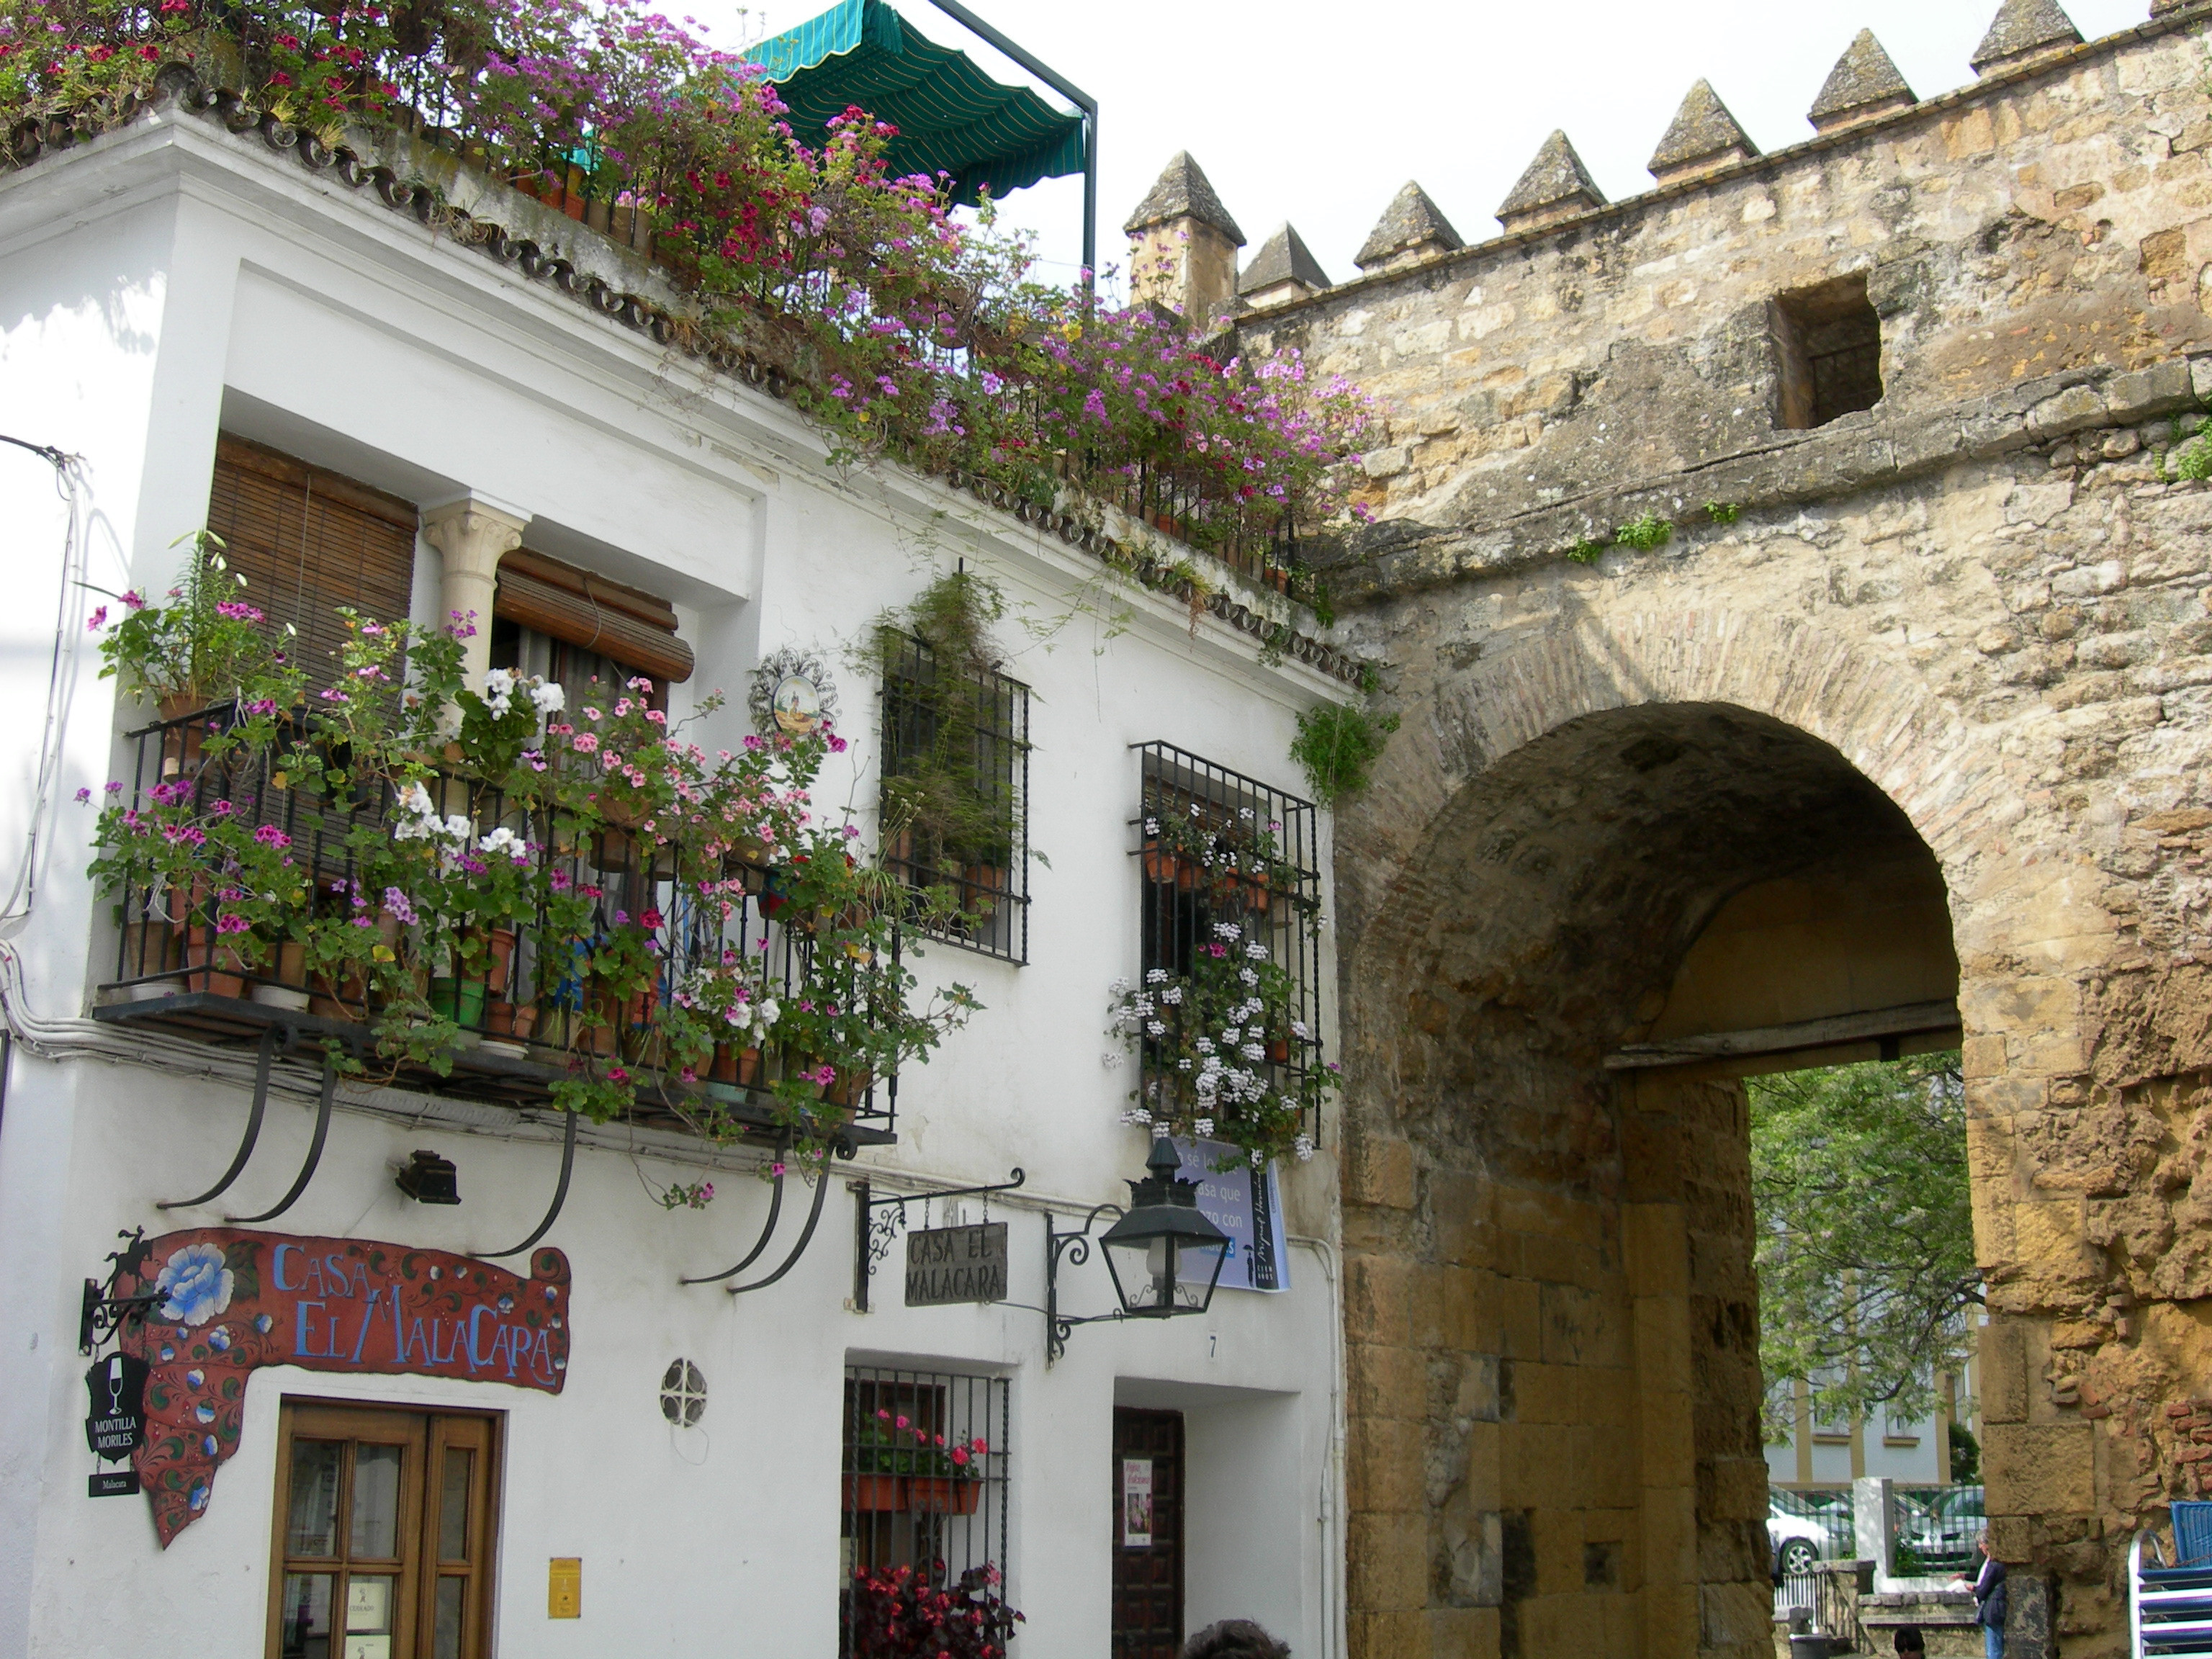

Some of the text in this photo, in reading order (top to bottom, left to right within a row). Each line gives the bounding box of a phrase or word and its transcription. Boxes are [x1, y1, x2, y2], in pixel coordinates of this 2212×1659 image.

[1187, 1151, 1200, 1168] sé
[1195, 1182, 1241, 1203] asa que
[1223, 1214, 1243, 1228] con
[910, 1229, 992, 1265] CASA EL
[907, 1264, 1001, 1300] MALACARA
[1210, 1336, 1217, 1358] 7
[94, 1416, 137, 1433] MONTILLA
[97, 1432, 133, 1448] MORILES
[103, 1479, 127, 1489] Malacara
